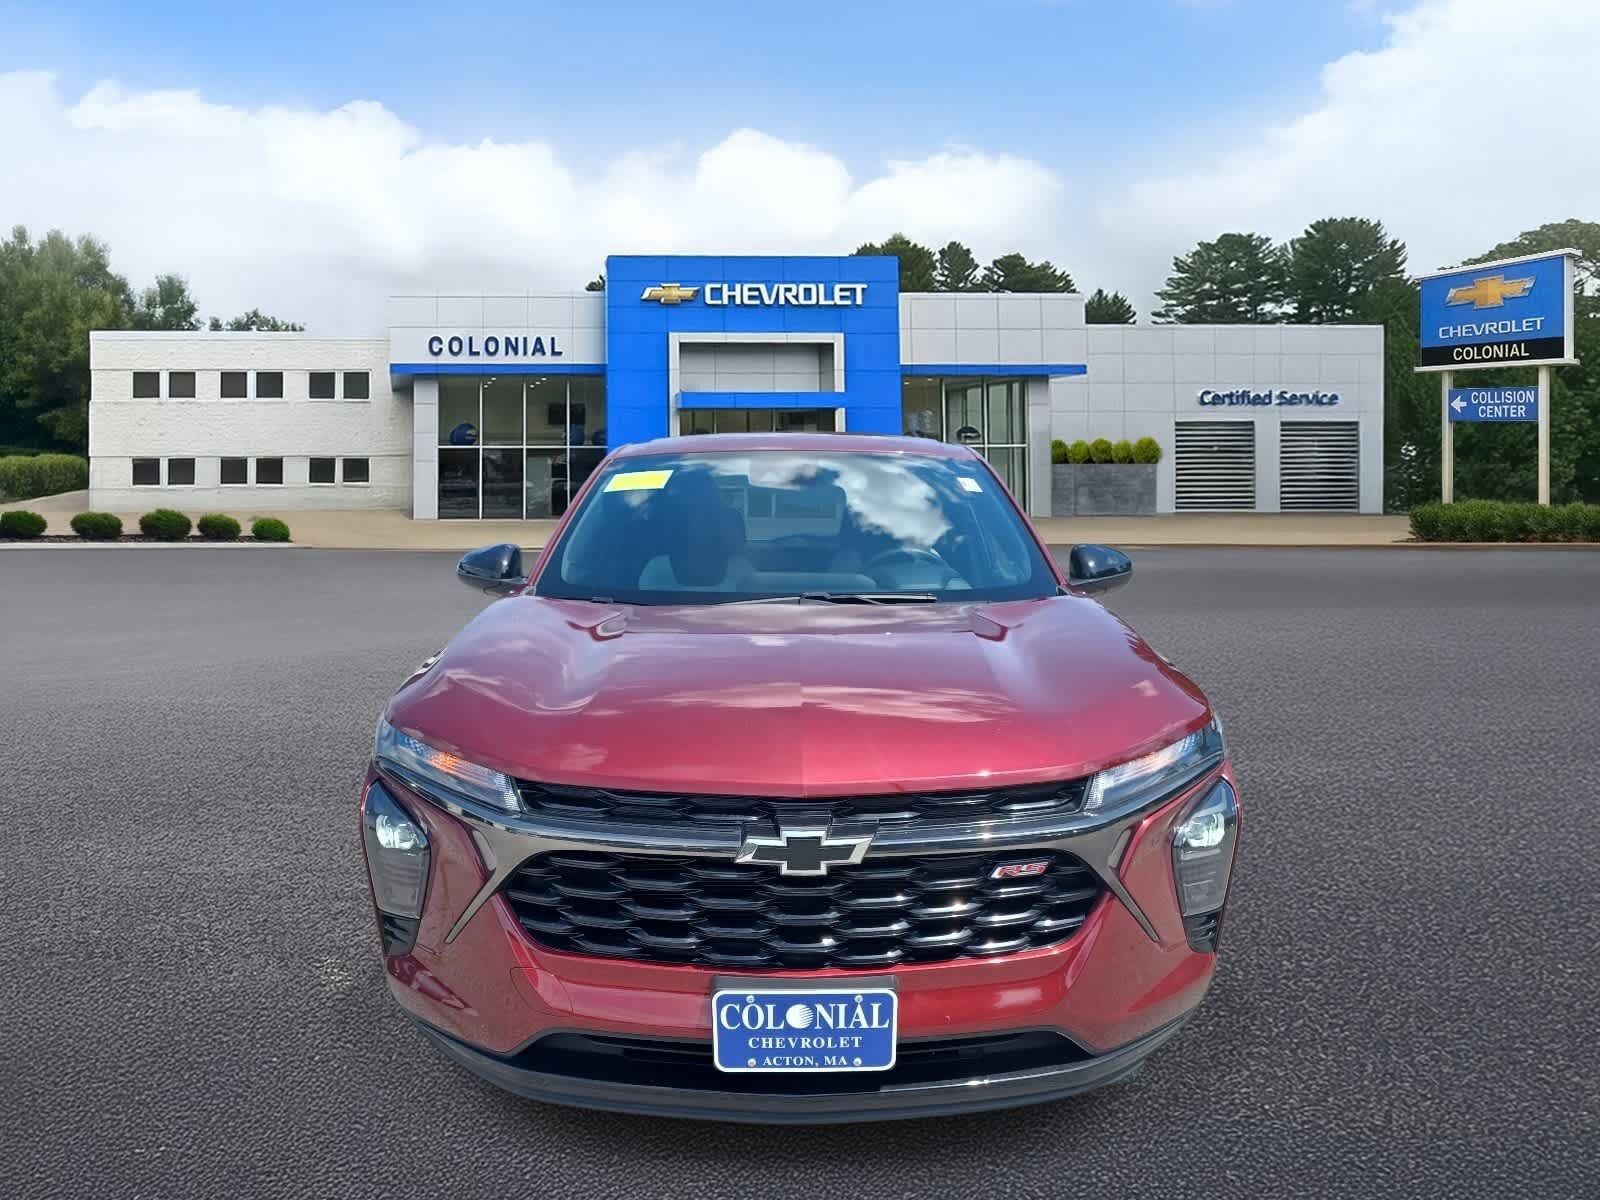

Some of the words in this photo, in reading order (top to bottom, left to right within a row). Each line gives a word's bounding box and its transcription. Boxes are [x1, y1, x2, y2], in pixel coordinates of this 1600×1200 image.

[704, 283, 868, 307] CHEVROLET
[1439, 317, 1544, 339] CHEVROLET
[428, 335, 564, 357] COLONIAL
[1453, 343, 1530, 361] COLONIAL
[1199, 390, 1273, 407] Certified
[1276, 390, 1339, 407] Service
[1471, 390, 1535, 404] COLLISION
[1478, 405, 1526, 418] CENTER
[991, 862, 1048, 879] RS
[720, 1003, 890, 1030] COLONIAL
[748, 1036, 863, 1049] CHEVROLET
[762, 1055, 819, 1067] ACTON,
[824, 1055, 848, 1066] MA
